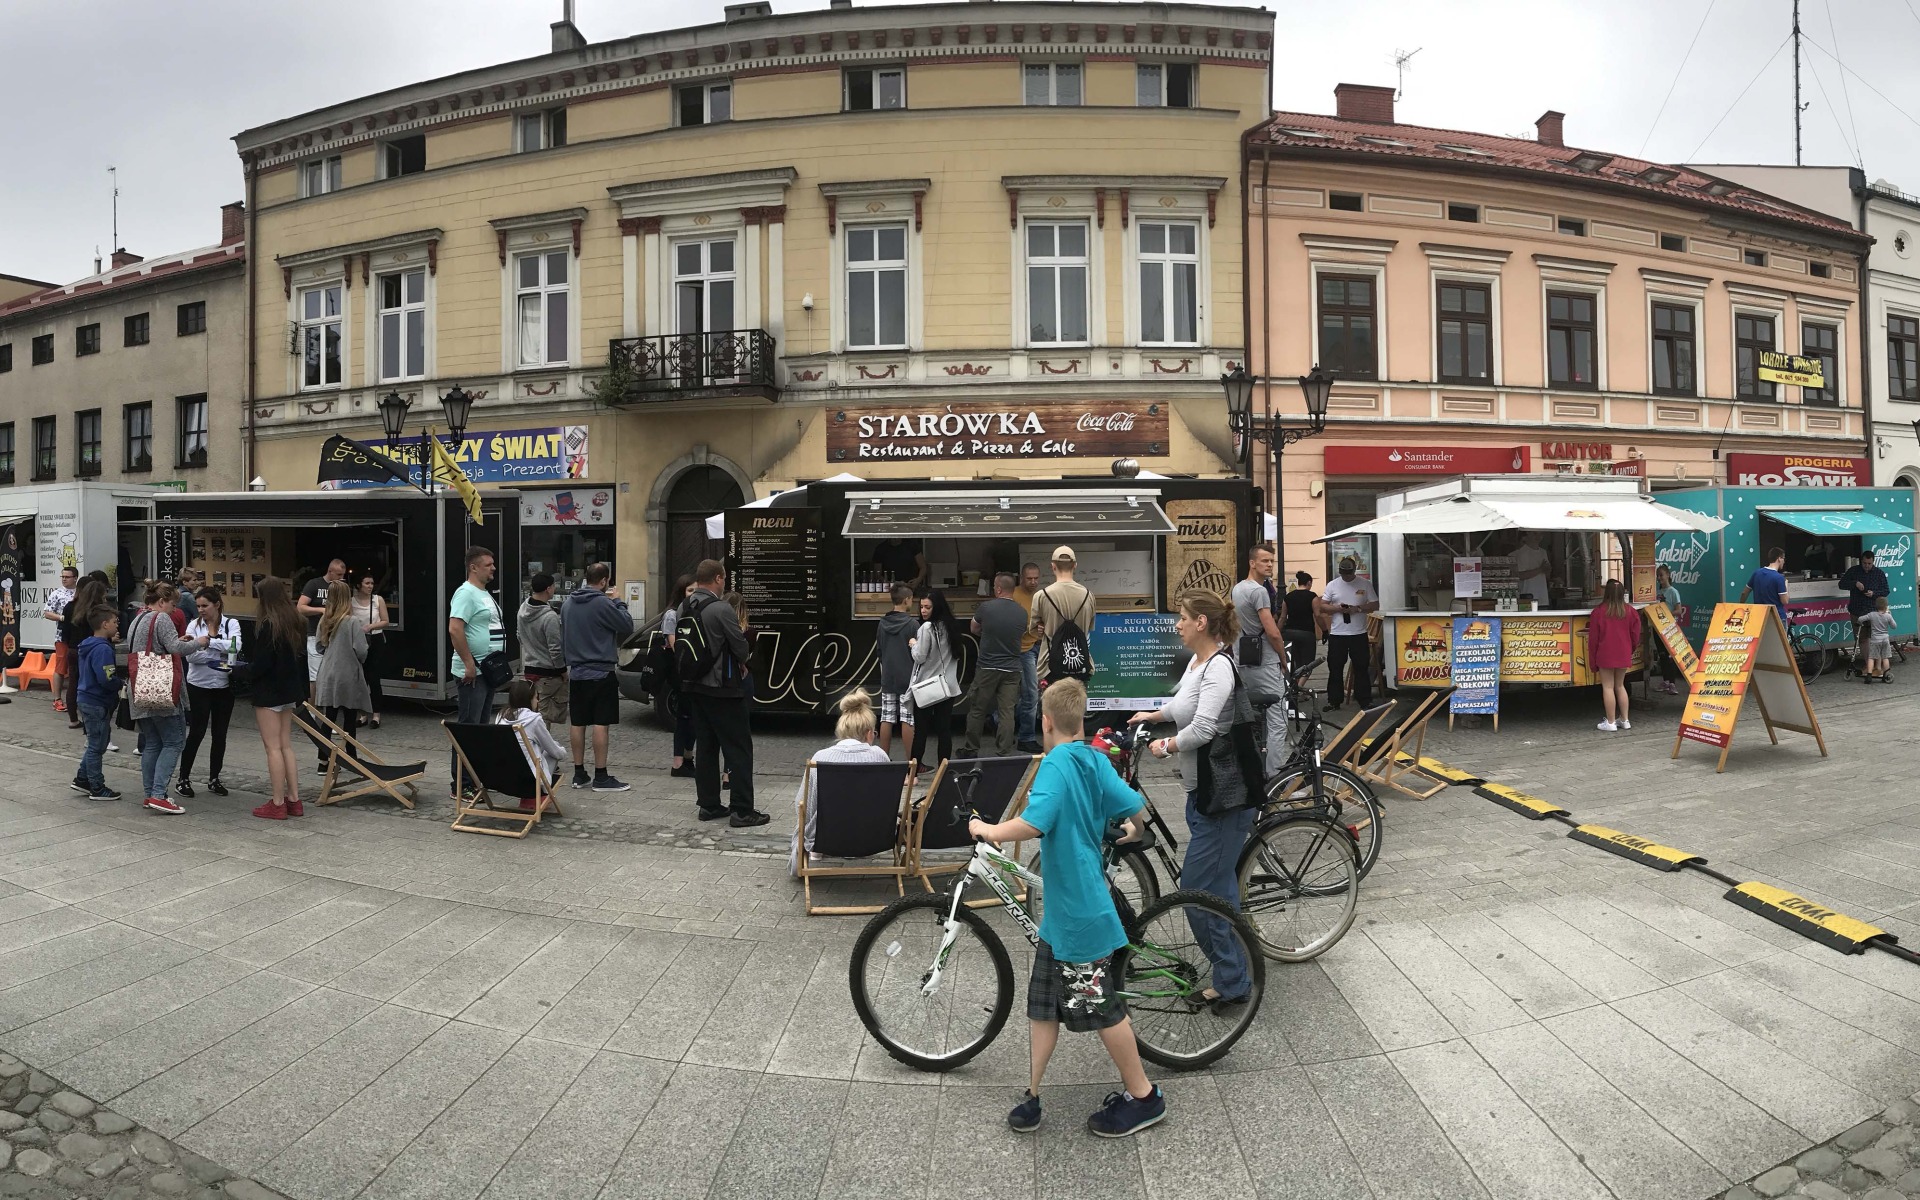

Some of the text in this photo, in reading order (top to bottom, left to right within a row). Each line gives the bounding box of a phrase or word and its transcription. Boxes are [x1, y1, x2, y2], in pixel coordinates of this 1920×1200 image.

[1760, 351, 1789, 369] LOKALE
[1076, 411, 1138, 432] Coca-Cola
[490, 433, 562, 461] ŚWIAT
[859, 438, 1076, 458] Restaurant & Pizza & Cafe
[1541, 442, 1612, 460] KANTOR
[1404, 451, 1454, 462] Santander
[1784, 458, 1854, 468] DROGERIA
[1616, 466, 1638, 476] KANTOR
[1739, 466, 1857, 486] KOSMYK
[752, 517, 795, 528] menu
[1177, 521, 1227, 540] mięso
[20, 588, 38, 603] OSZ
[1148, 625, 1178, 634] OŚWIĘ
[1528, 622, 1563, 630] PALUCHY
[1508, 638, 1557, 648] WYŚMIENITA
[1456, 648, 1496, 656] CZEKOLADA
[1704, 653, 1749, 662] ZŁOTE PALUCHY
[1704, 663, 1742, 674] CHURROS
[1455, 674, 1495, 682] GRZANIEC
